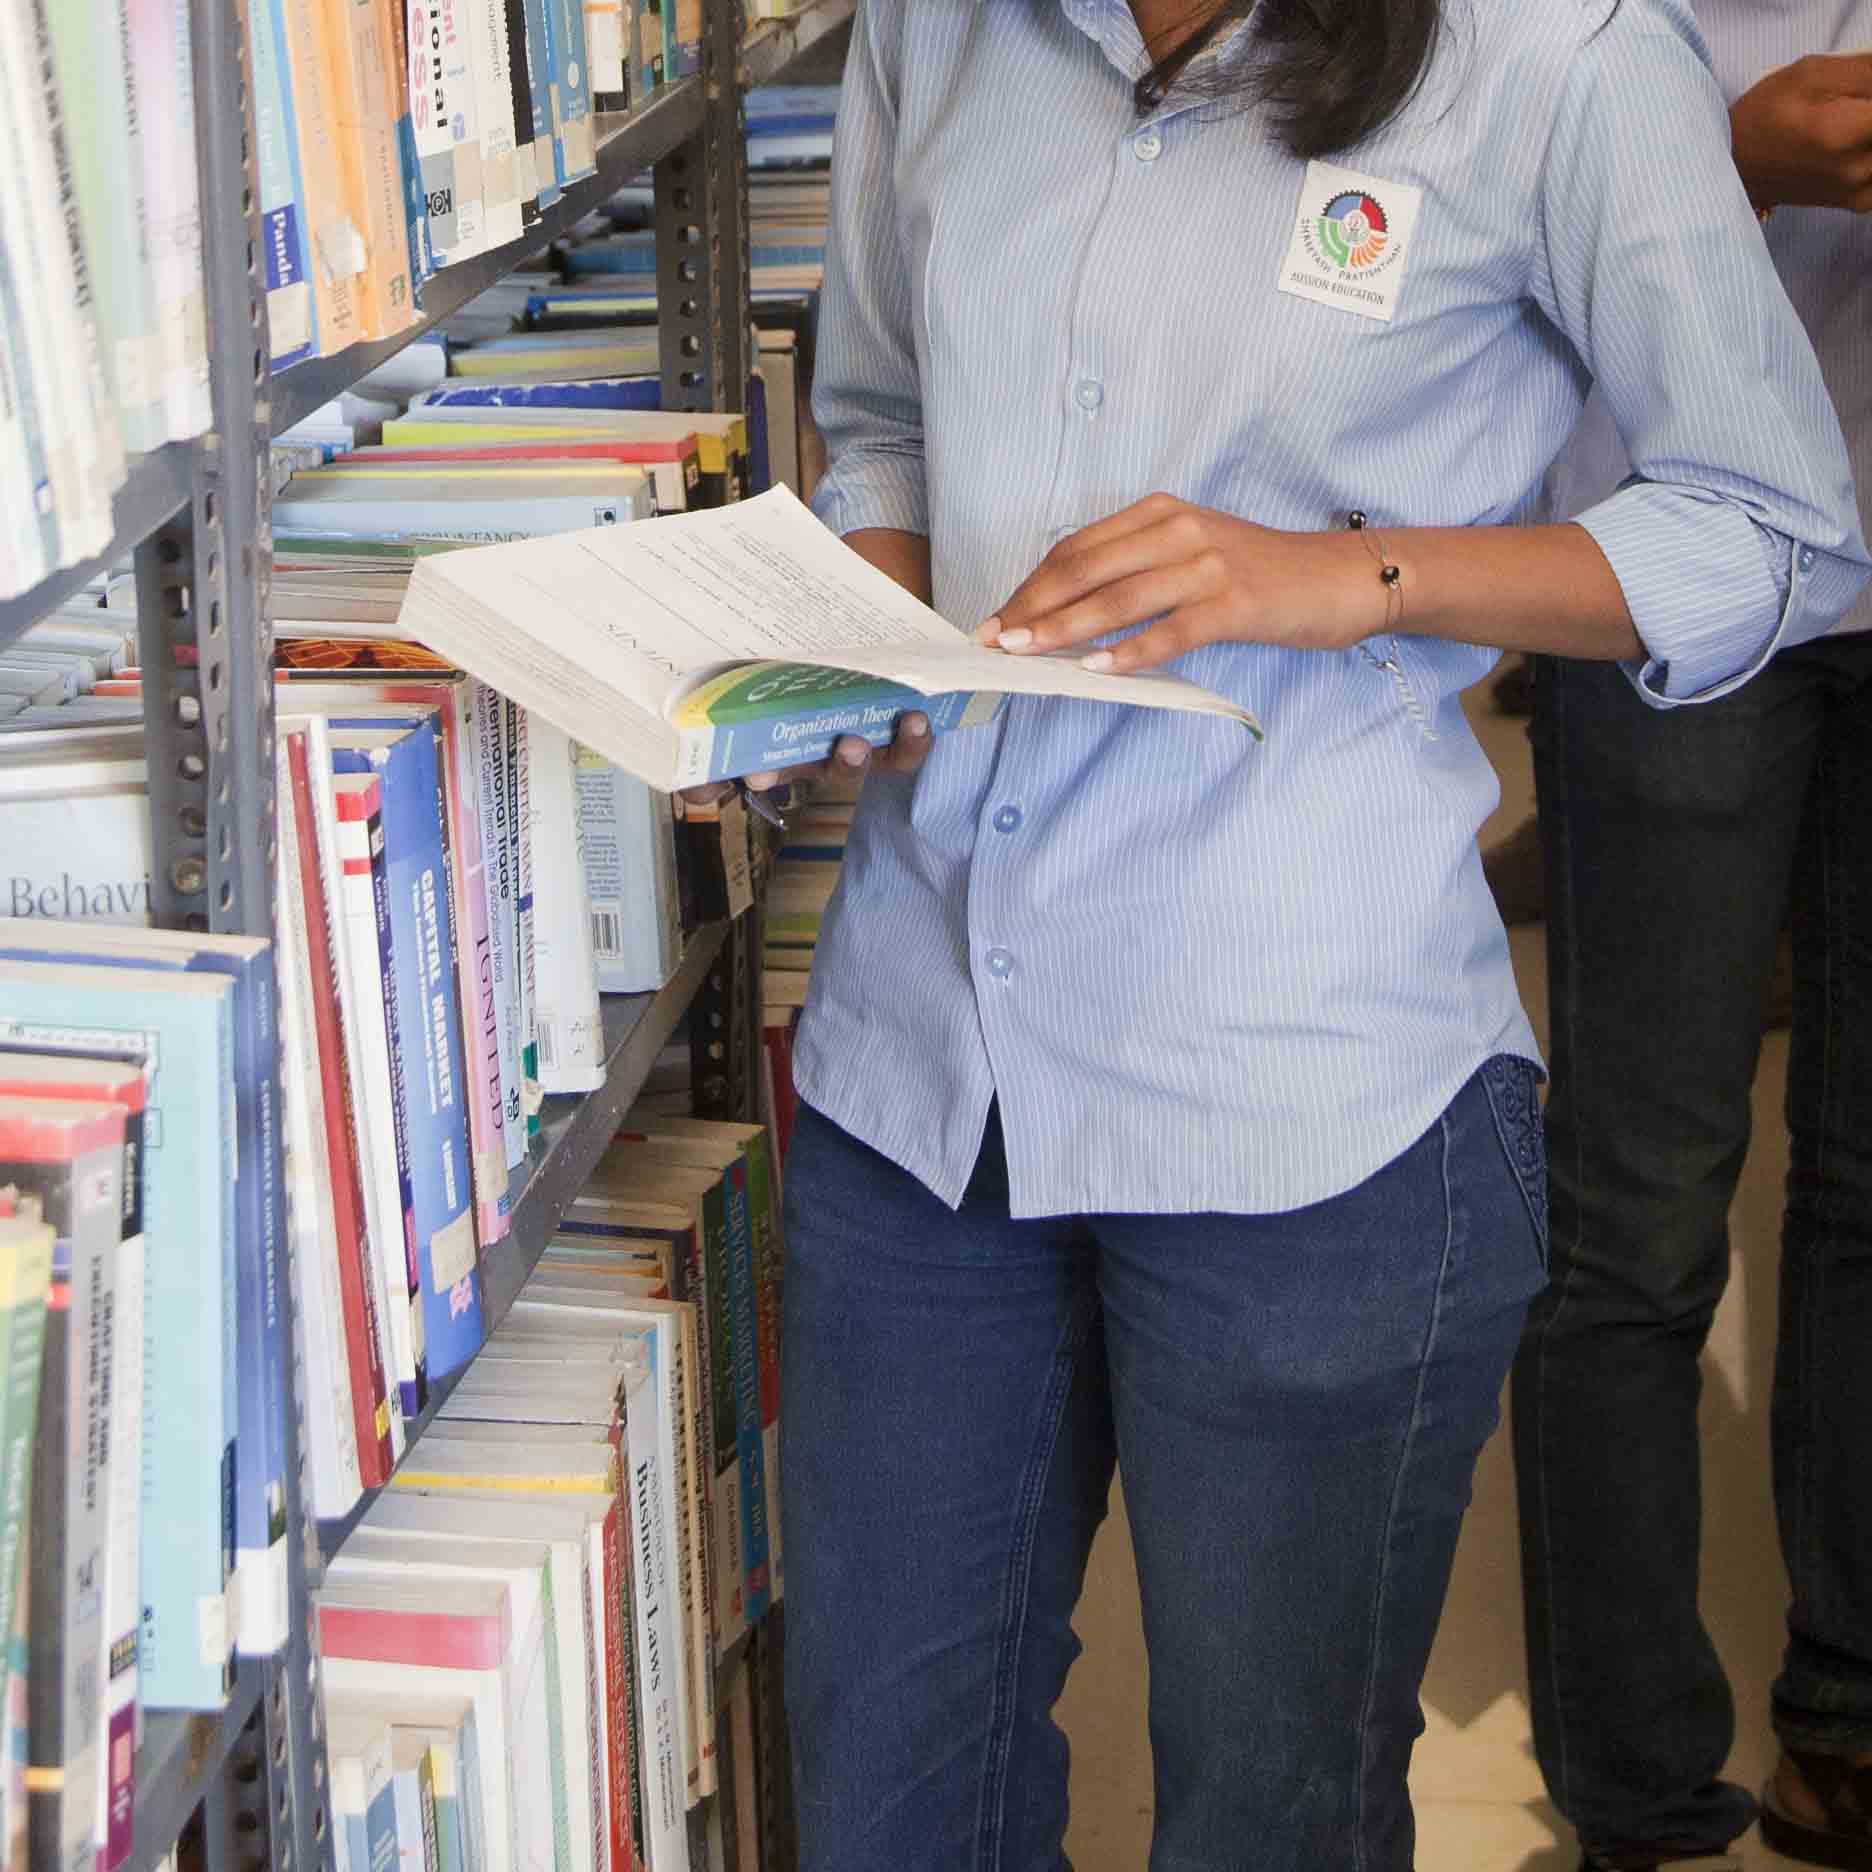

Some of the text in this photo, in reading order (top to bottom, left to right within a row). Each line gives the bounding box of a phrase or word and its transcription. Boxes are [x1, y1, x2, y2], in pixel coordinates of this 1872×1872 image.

[49, 124, 76, 204] INDIAN
[62, 206, 93, 309] CONTEXT
[1289, 270, 1385, 306] MISSION EDUCATION
[478, 734, 489, 758] and
[480, 761, 492, 805] Current
[488, 686, 511, 901] nternational Trade
[508, 756, 520, 838] Financial
[771, 710, 861, 743] Organization
[484, 807, 495, 846] Trends
[517, 747, 538, 996] CAPITAL MANEMENT
[423, 869, 453, 1108] CAPITAL MARKET
[475, 933, 504, 1130] IGNITED
[260, 1078, 277, 1329] CORPORATE GOVERNANCE
[83, 1254, 105, 1512] EXECUTING STRATEGY
[95, 1289, 114, 1469] CRAFTING AND
[729, 1190, 755, 1431] SERVICES MARKETING
[636, 1458, 663, 1692] Business Laws
[698, 1499, 711, 1616] Management
[626, 1673, 641, 1818] METHODOLOGY
